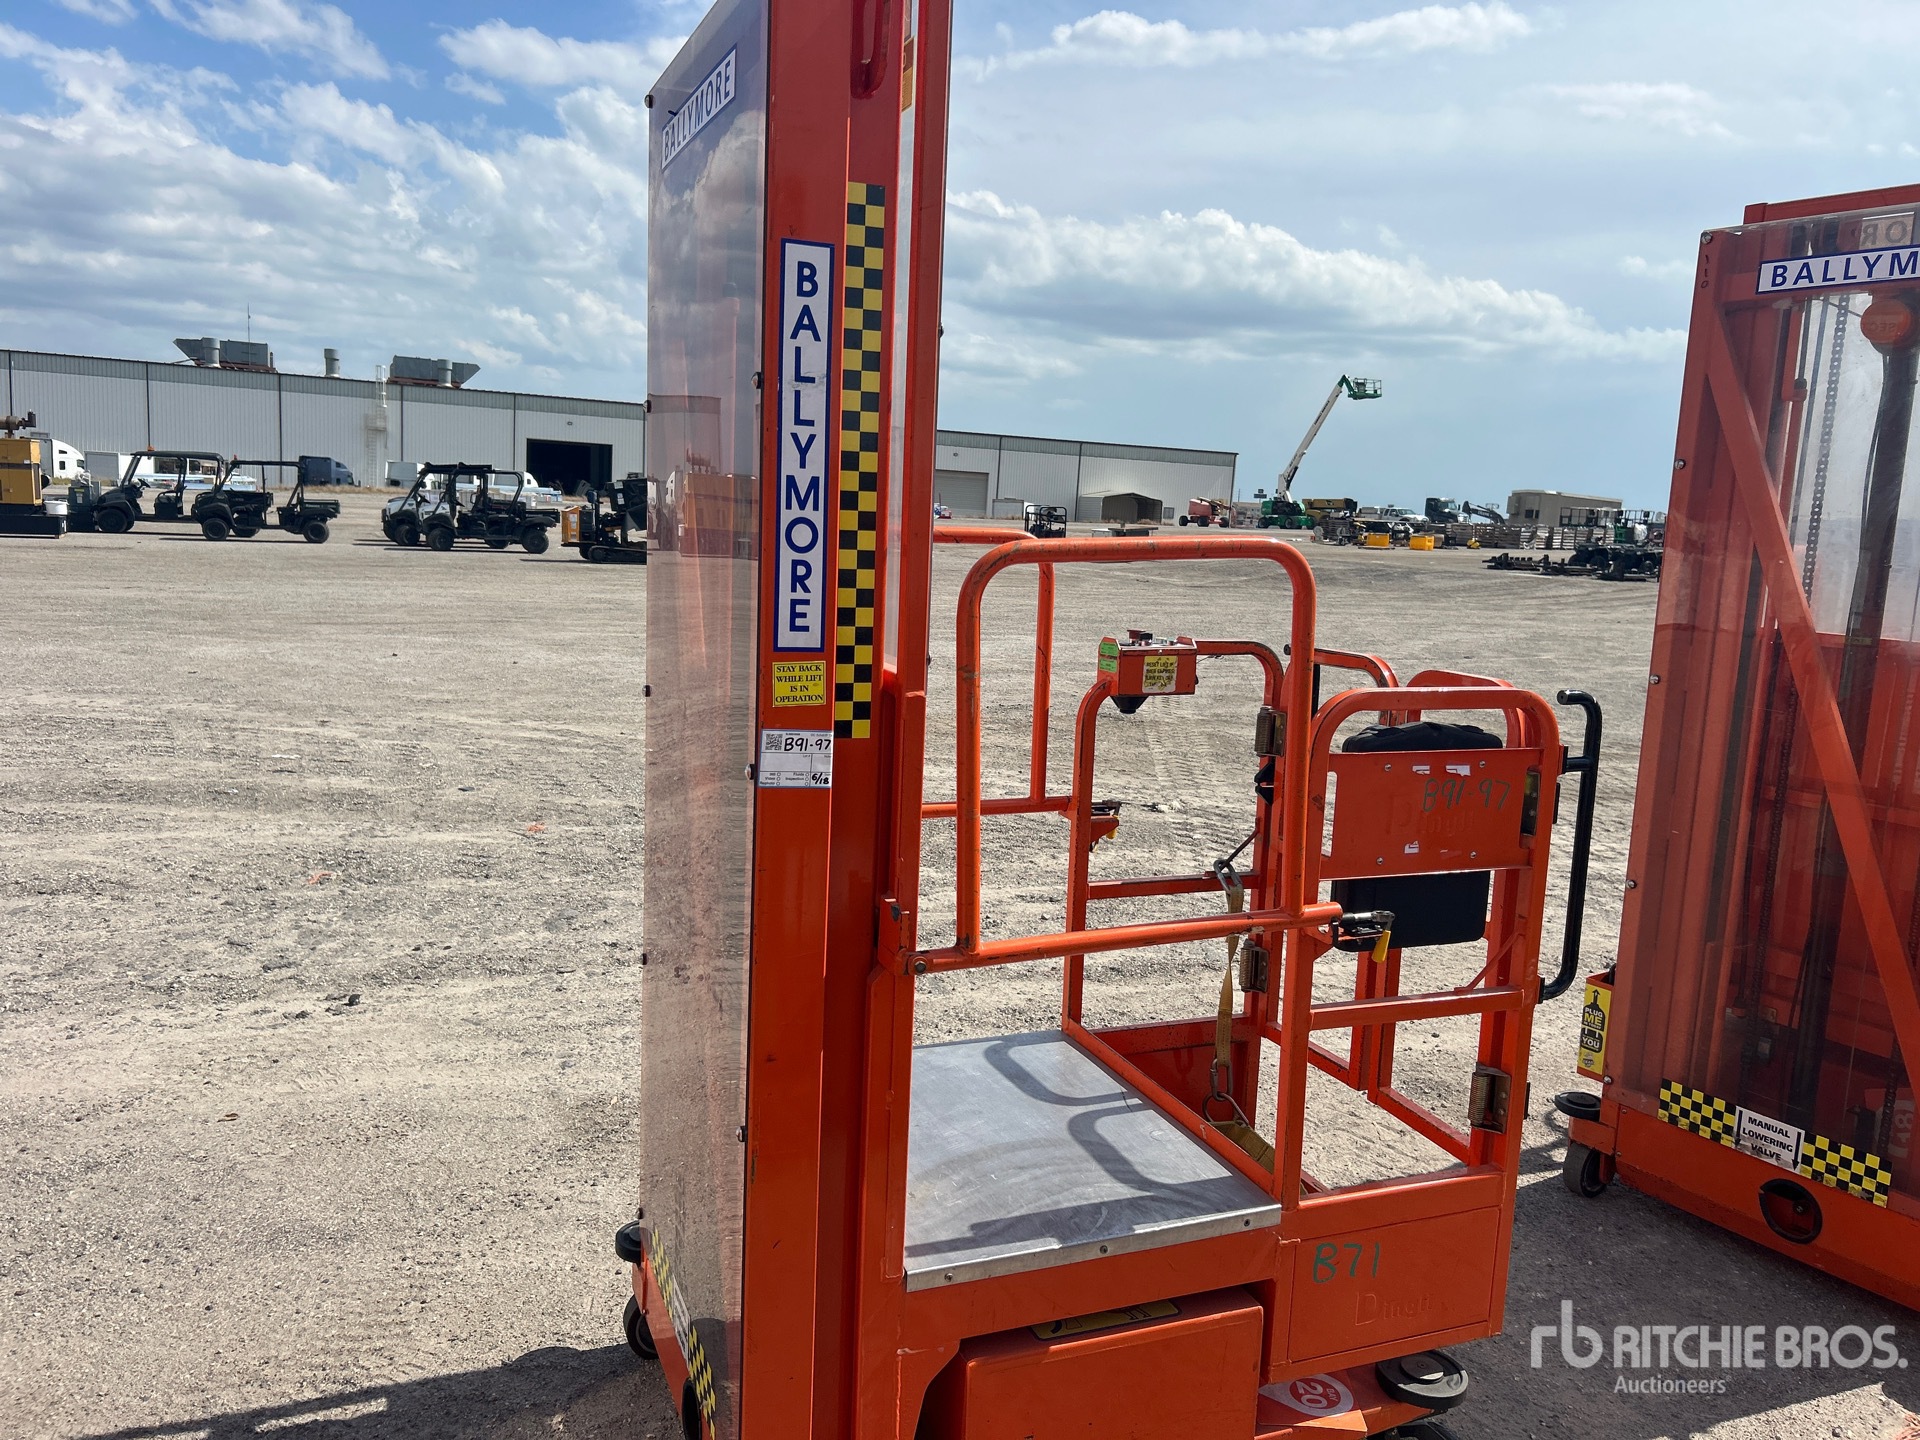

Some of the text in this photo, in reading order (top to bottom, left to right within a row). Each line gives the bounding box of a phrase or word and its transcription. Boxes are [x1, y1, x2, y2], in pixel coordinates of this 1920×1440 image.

[664, 59, 731, 161] BALLYMORE
[785, 261, 821, 632] BALLYMORE
[806, 674, 823, 682] LIFT
[775, 695, 823, 703] OPERATION
[784, 737, 832, 752] B91-97
[811, 773, 830, 785] 6/18
[1422, 778, 1511, 813] B91-97
[1584, 1007, 1603, 1018] PLUG
[1584, 1013, 1603, 1027] ME
[1582, 1037, 1600, 1048] YOU
[1748, 1117, 1791, 1138] MANUAL
[1742, 1128, 1793, 1152] LOWERING
[1751, 1143, 1782, 1161] VALVE
[1312, 1241, 1380, 1284] B71
[1294, 1382, 1328, 1408] 20
